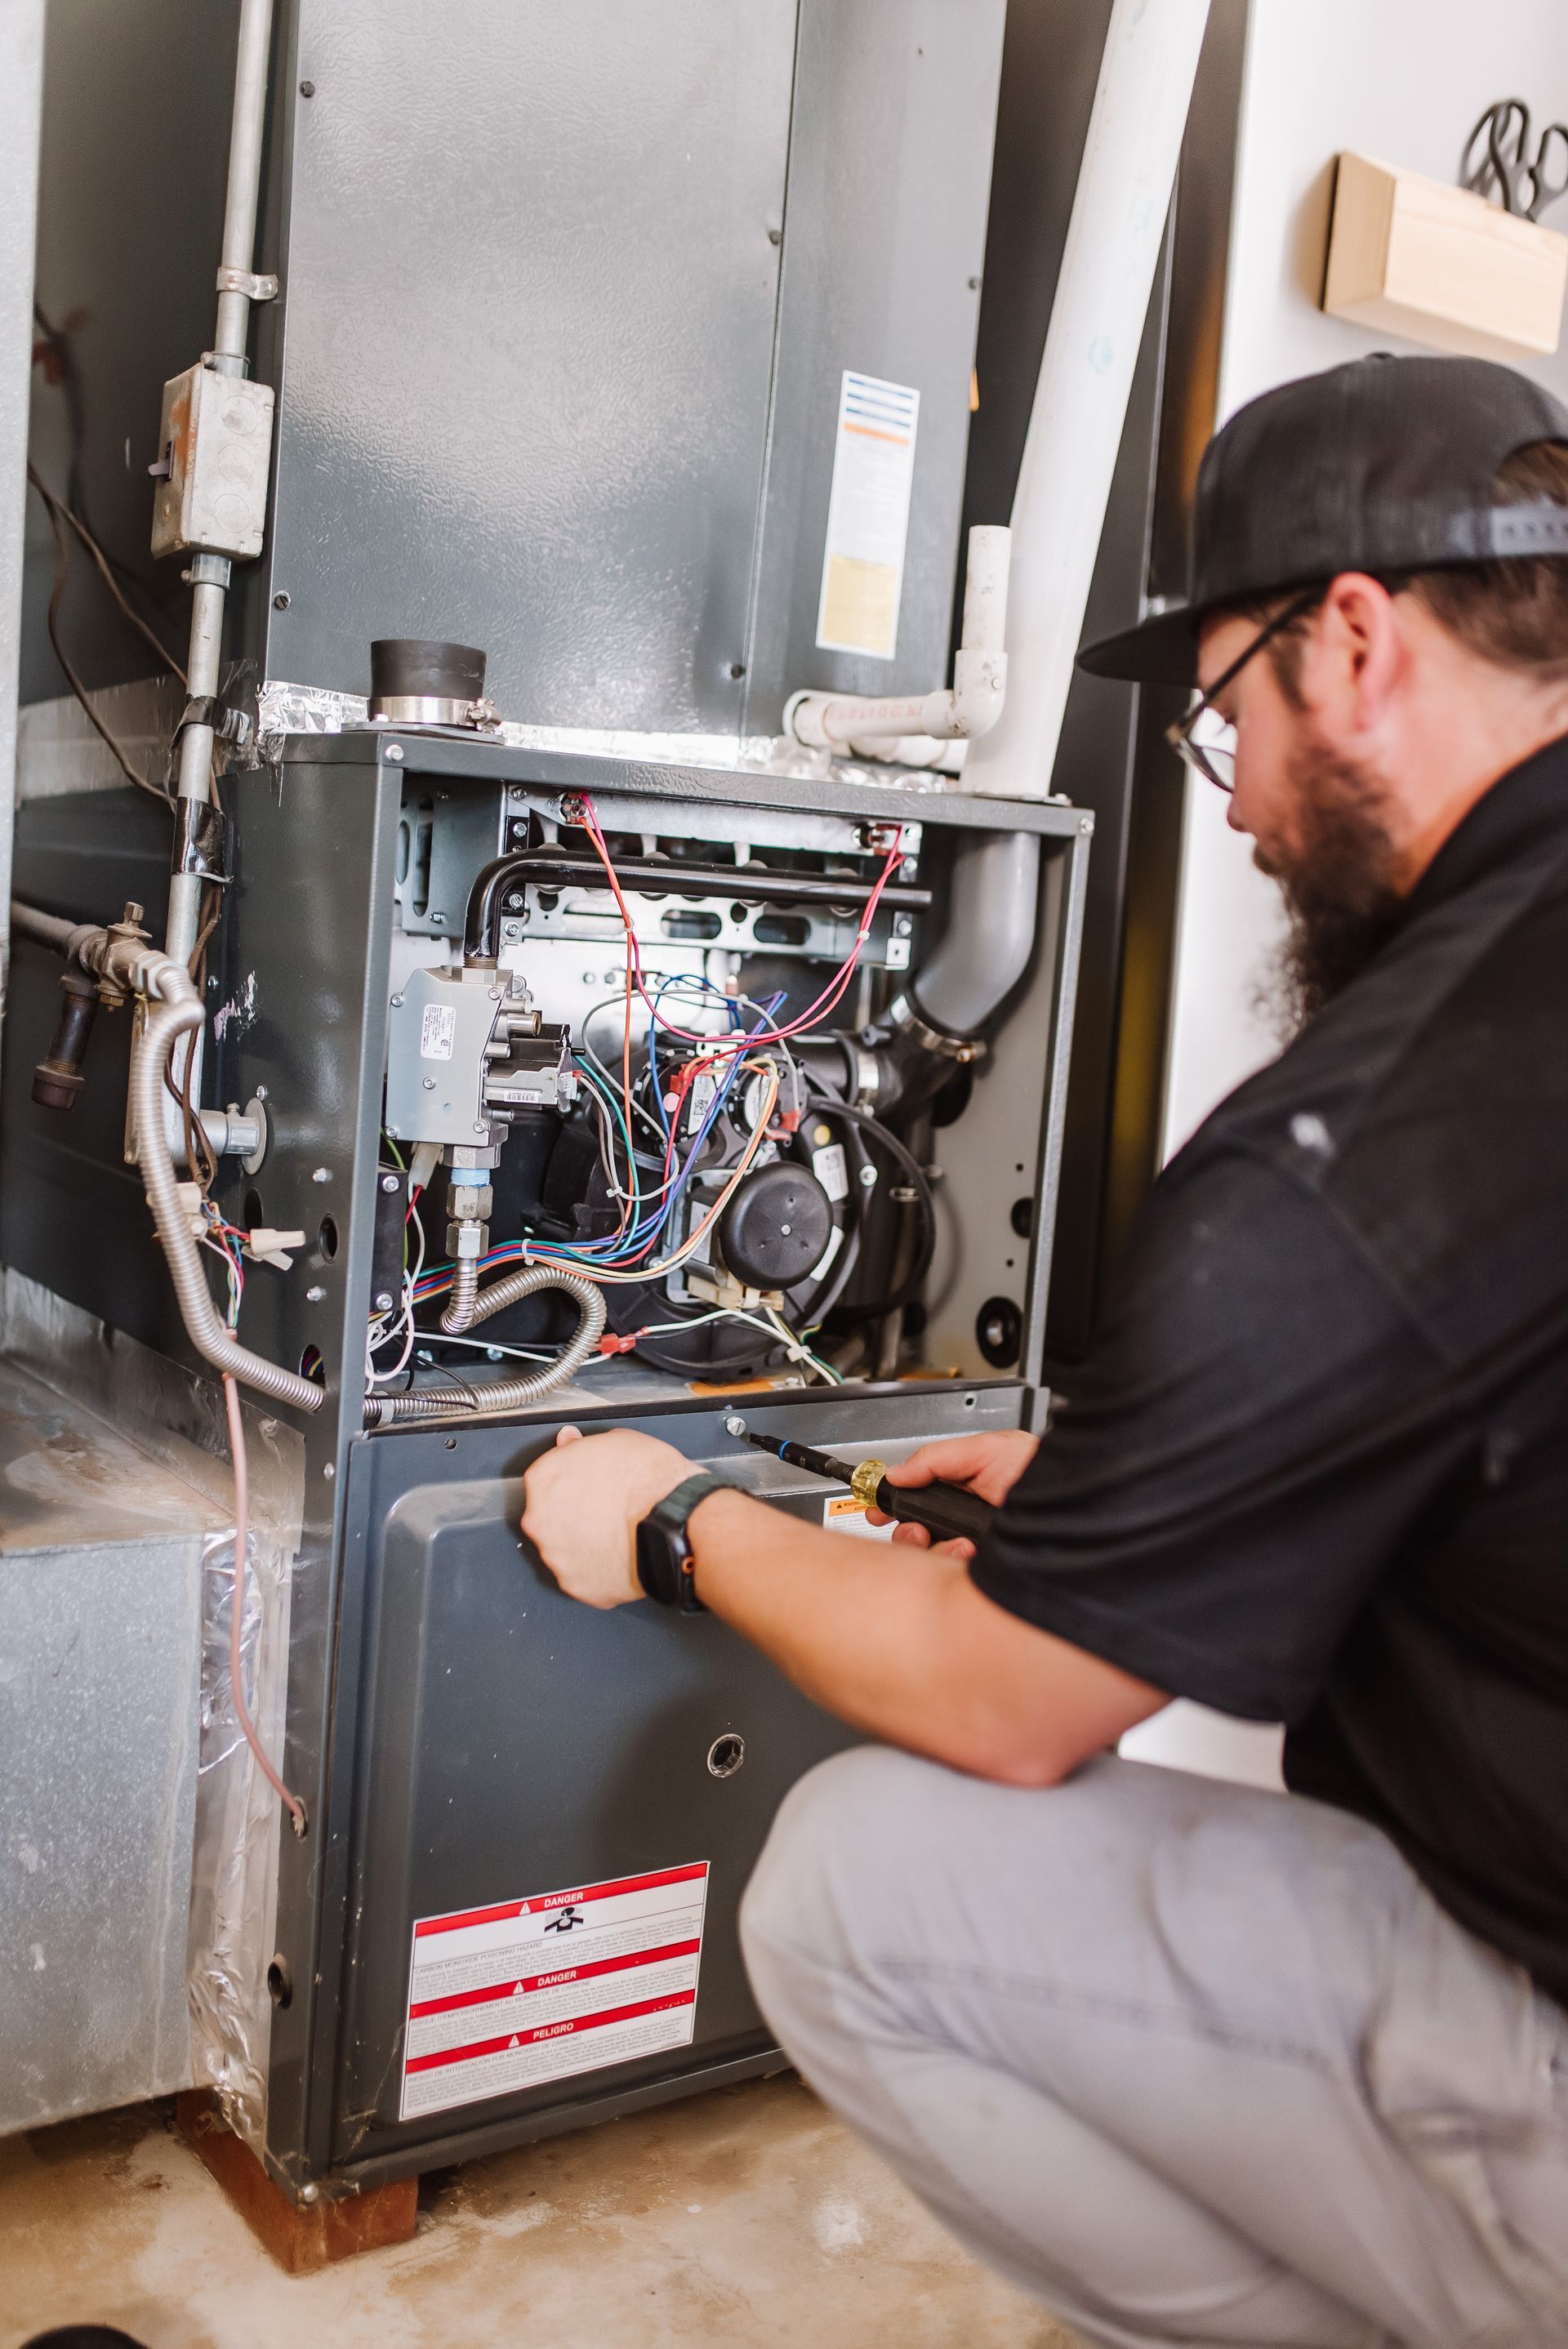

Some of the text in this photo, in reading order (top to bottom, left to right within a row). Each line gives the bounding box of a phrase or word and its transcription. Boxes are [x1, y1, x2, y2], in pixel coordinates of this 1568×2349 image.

[543, 1891, 584, 1908] DANGER
[415, 1941, 542, 1975] CARBON MONOXIDE POISONING HAZARD
[537, 1969, 577, 1987] DANGER
[411, 2017, 434, 2028] RISQUE
[504, 1998, 513, 2006] AU
[561, 1980, 590, 1992] CARBONE
[532, 2021, 574, 2040] PELIGRO
[408, 2071, 433, 2084] RIESGO
[434, 2069, 443, 2077] DE
[491, 2053, 506, 2062] POR
[551, 2034, 581, 2047] CARBONO
